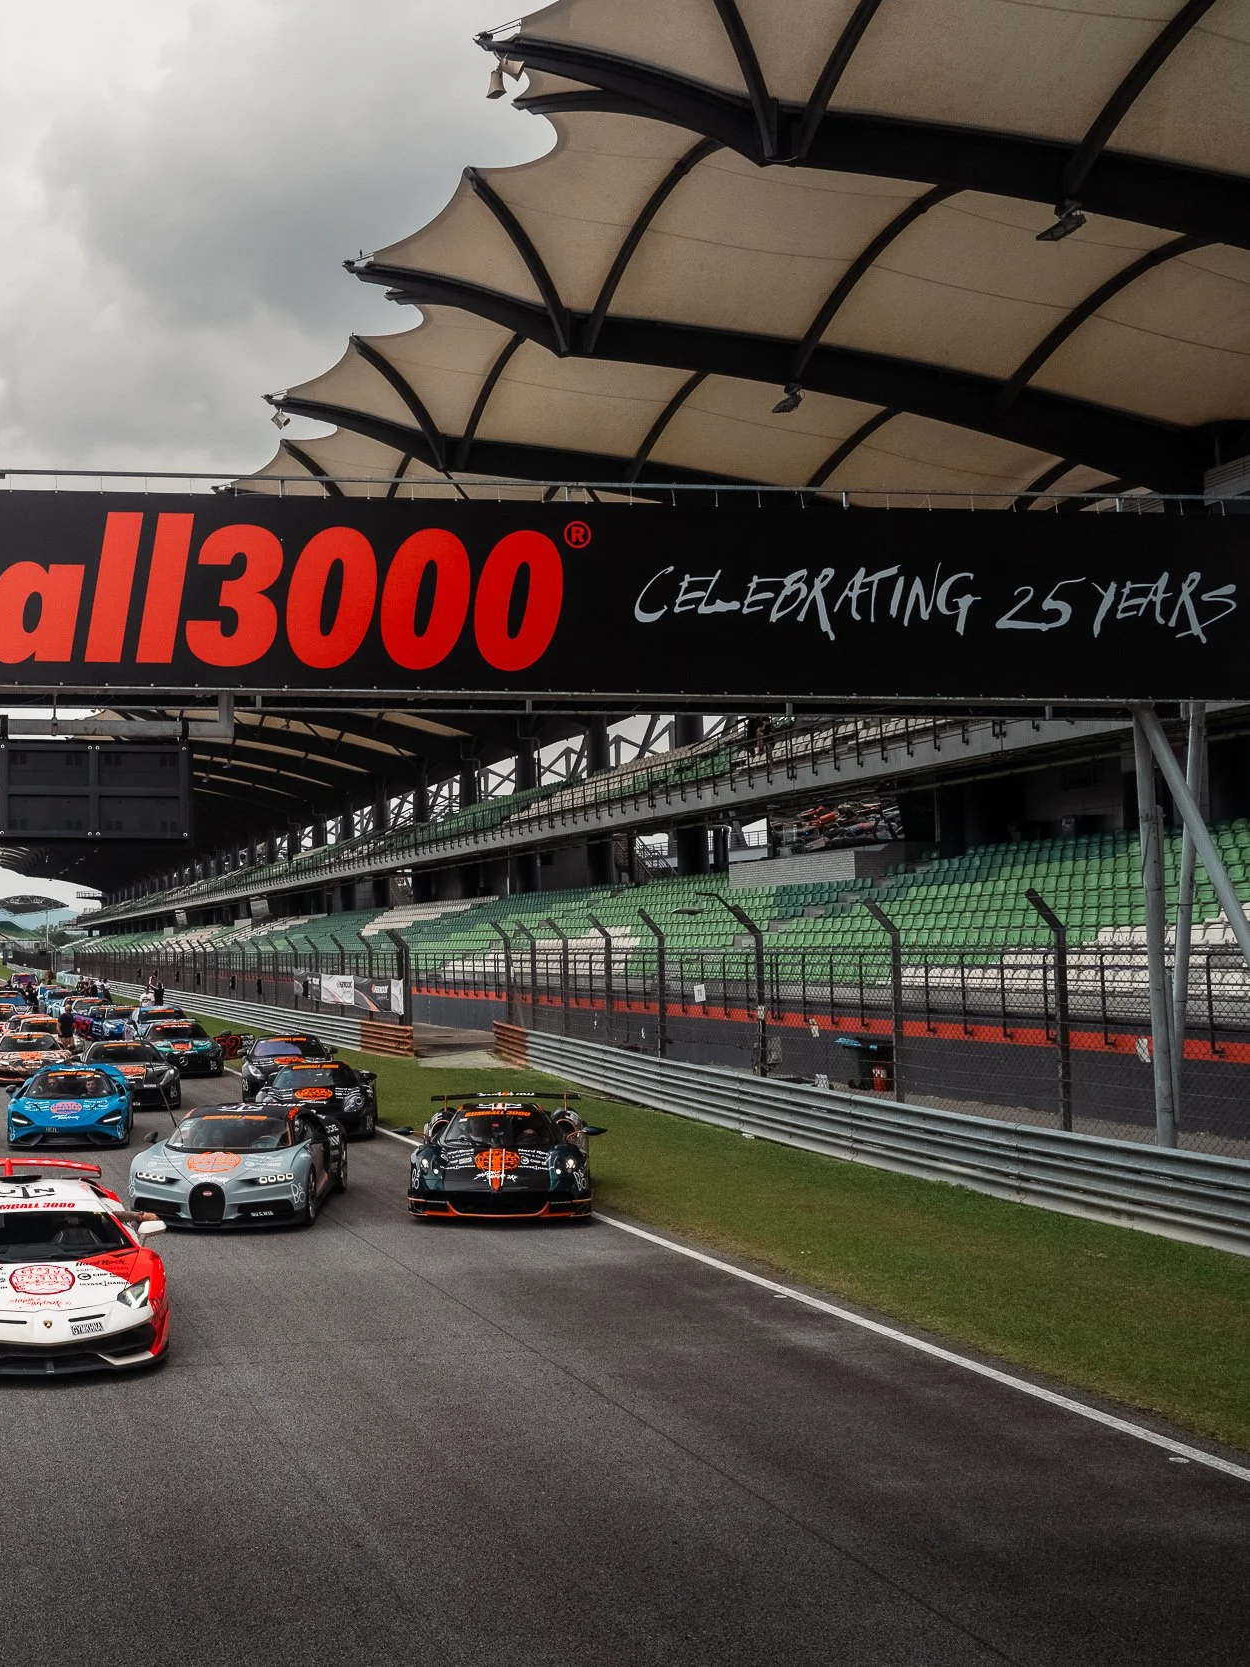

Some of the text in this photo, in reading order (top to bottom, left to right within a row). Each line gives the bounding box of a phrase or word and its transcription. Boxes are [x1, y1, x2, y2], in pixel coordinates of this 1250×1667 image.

[634, 562, 1237, 643] CELEBRATING 25 YEARS
